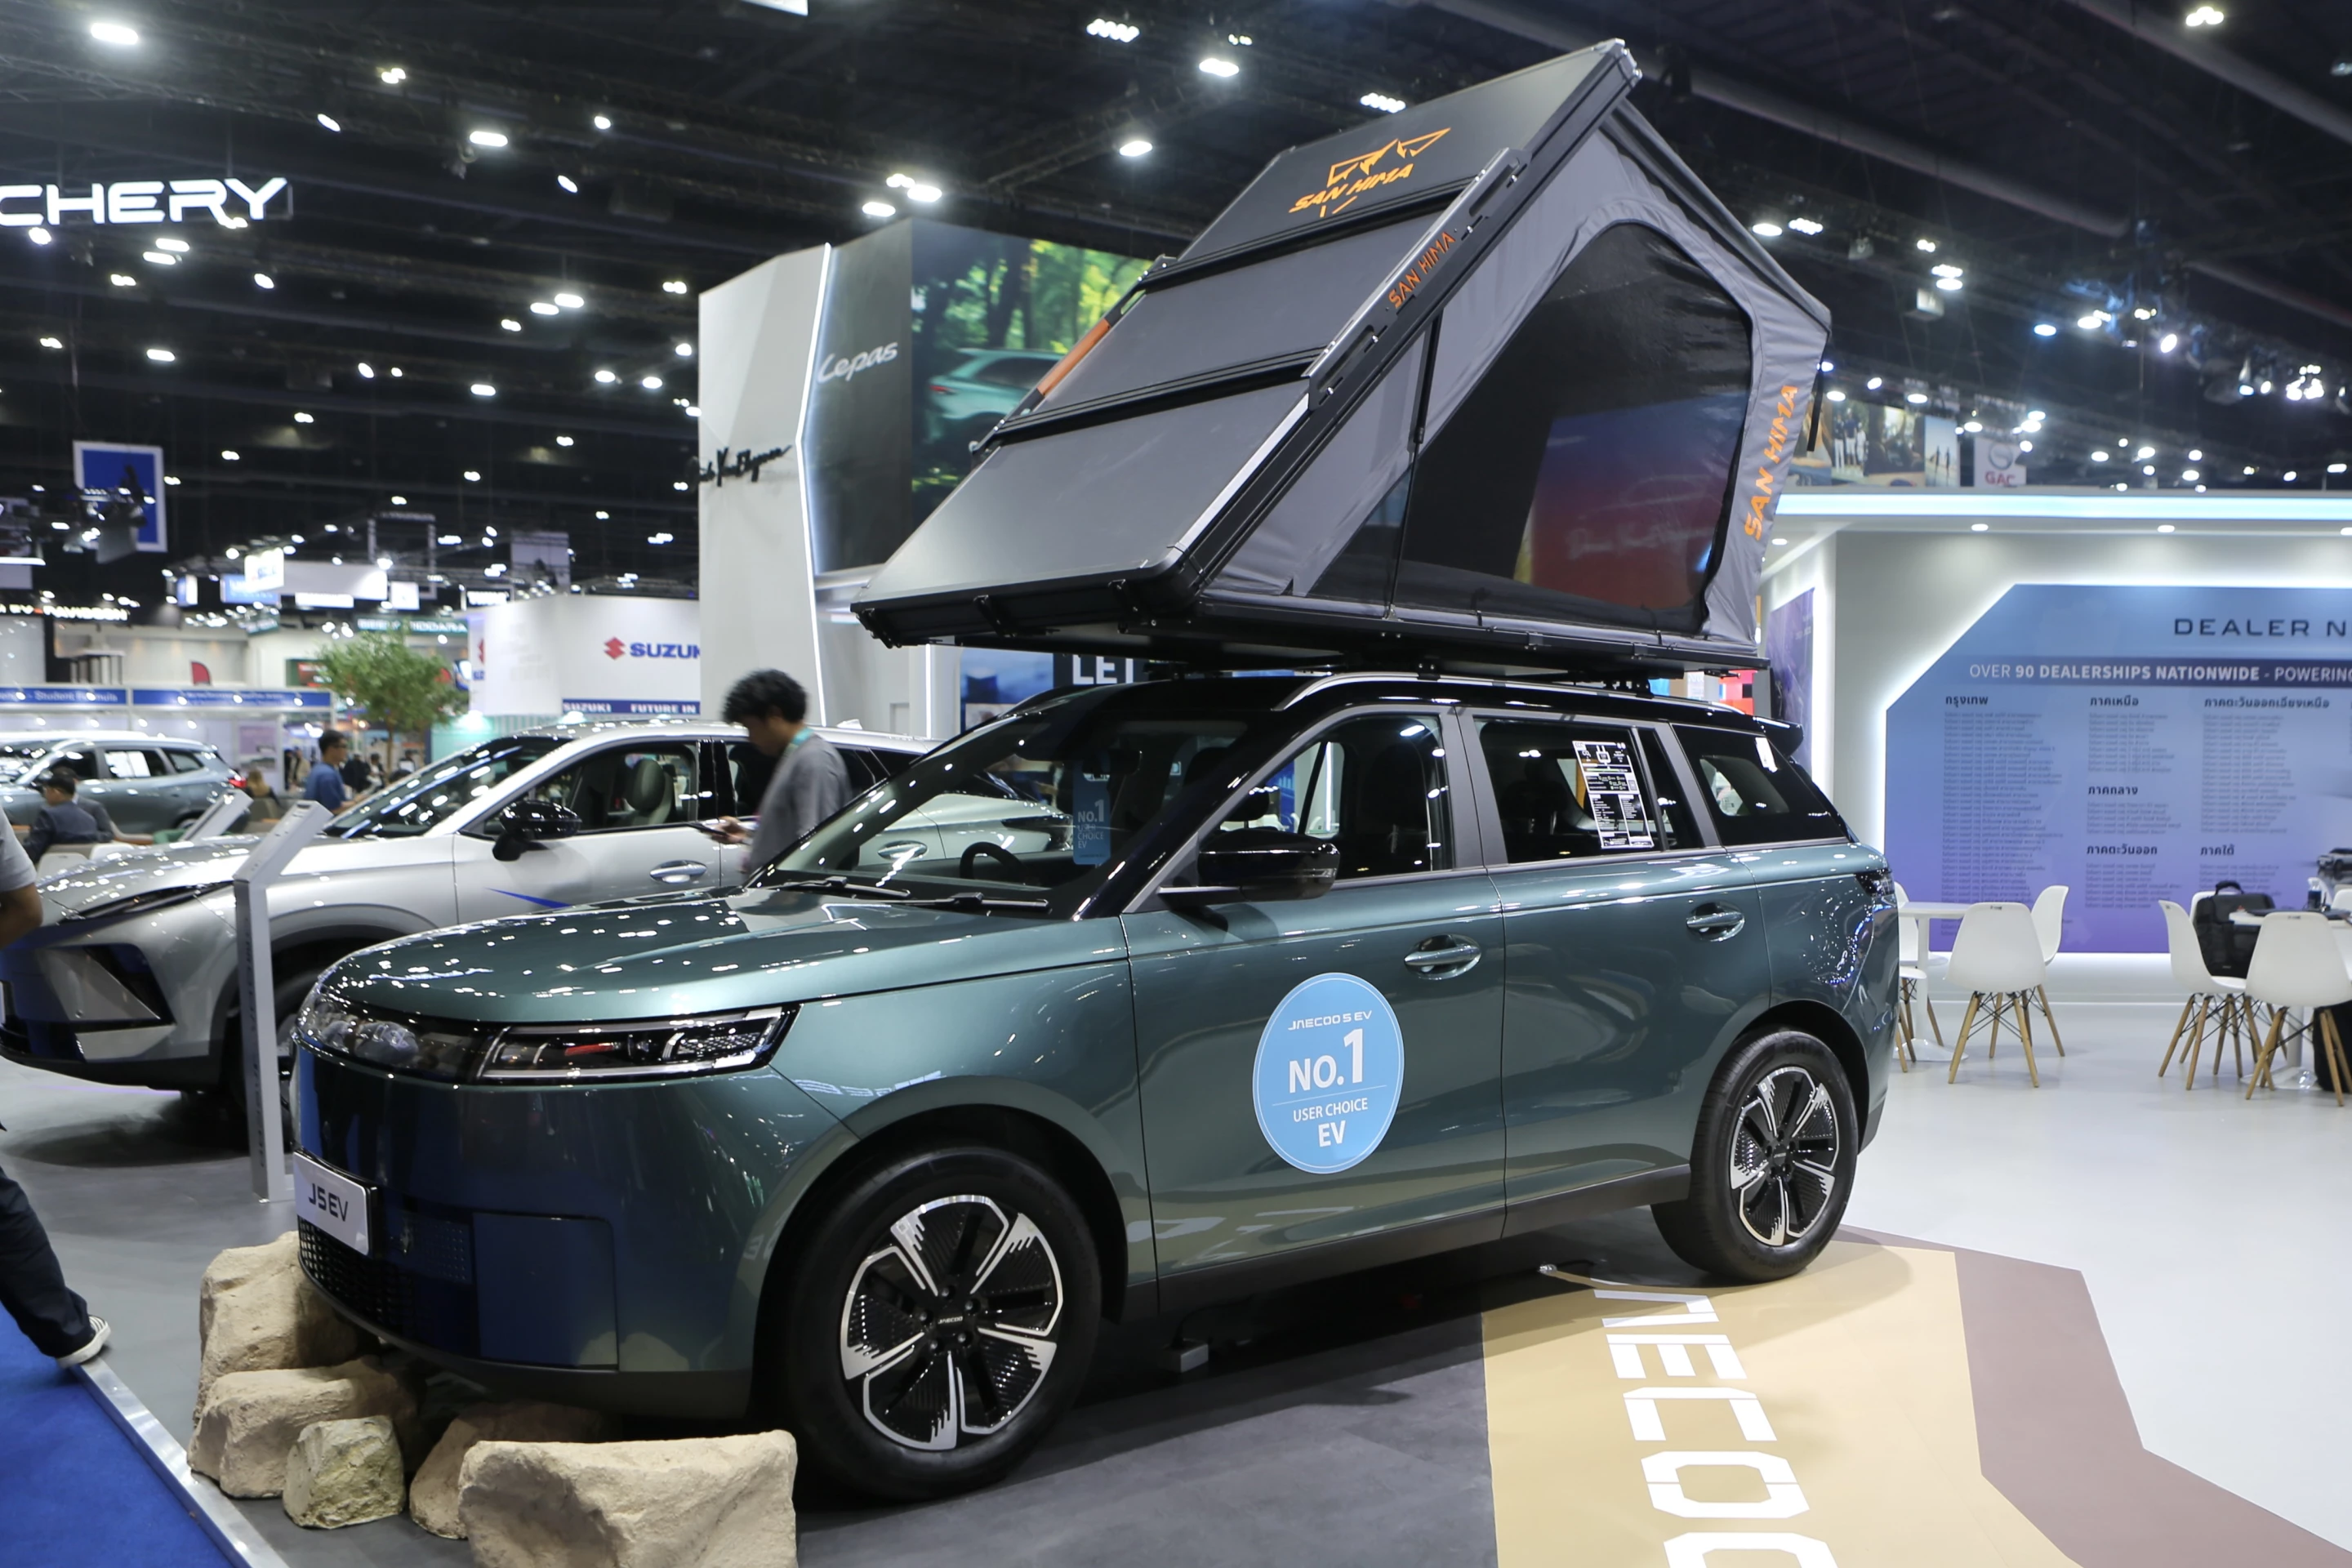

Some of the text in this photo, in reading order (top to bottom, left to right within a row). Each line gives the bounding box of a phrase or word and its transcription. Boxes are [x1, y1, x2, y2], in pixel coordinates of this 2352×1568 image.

[1289, 163, 1414, 213] SAN HIMA
[0, 177, 287, 229] CHERY
[1389, 232, 1455, 309] SAN HIMA
[817, 341, 898, 384] Lepas
[1744, 385, 1797, 541] SAN HIMA
[1984, 471, 2016, 486] GAC
[2175, 618, 2352, 638] DEALER N
[1970, 664, 2011, 678] OVER
[2015, 665, 2034, 678] 90
[2039, 665, 2151, 679] DEALERSHIPS
[2156, 666, 2260, 681] NATIONWIDE
[630, 704, 696, 713] FUTURE IN
[1945, 695, 1989, 707] กรุงเทพ
[2090, 694, 2139, 706] ภาคเหนือ
[2205, 697, 2330, 709] ภาคตะวันออกเฉียงเหนือ
[2088, 785, 2138, 795] ภาคกลาง
[1077, 799, 1104, 822] NO.1
[1077, 831, 1104, 840] CHOICE
[1078, 840, 1087, 849] EV
[2087, 843, 2158, 855] ภาคตะวันออก
[2200, 844, 2234, 856] ภาคใต้
[1354, 1010, 1373, 1021] EV
[1289, 1028, 1364, 1094] NO.1
[1294, 1098, 1368, 1122] USER CHOICE
[1318, 1120, 1346, 1147] EV
[1590, 1278, 1839, 1568] AECO
